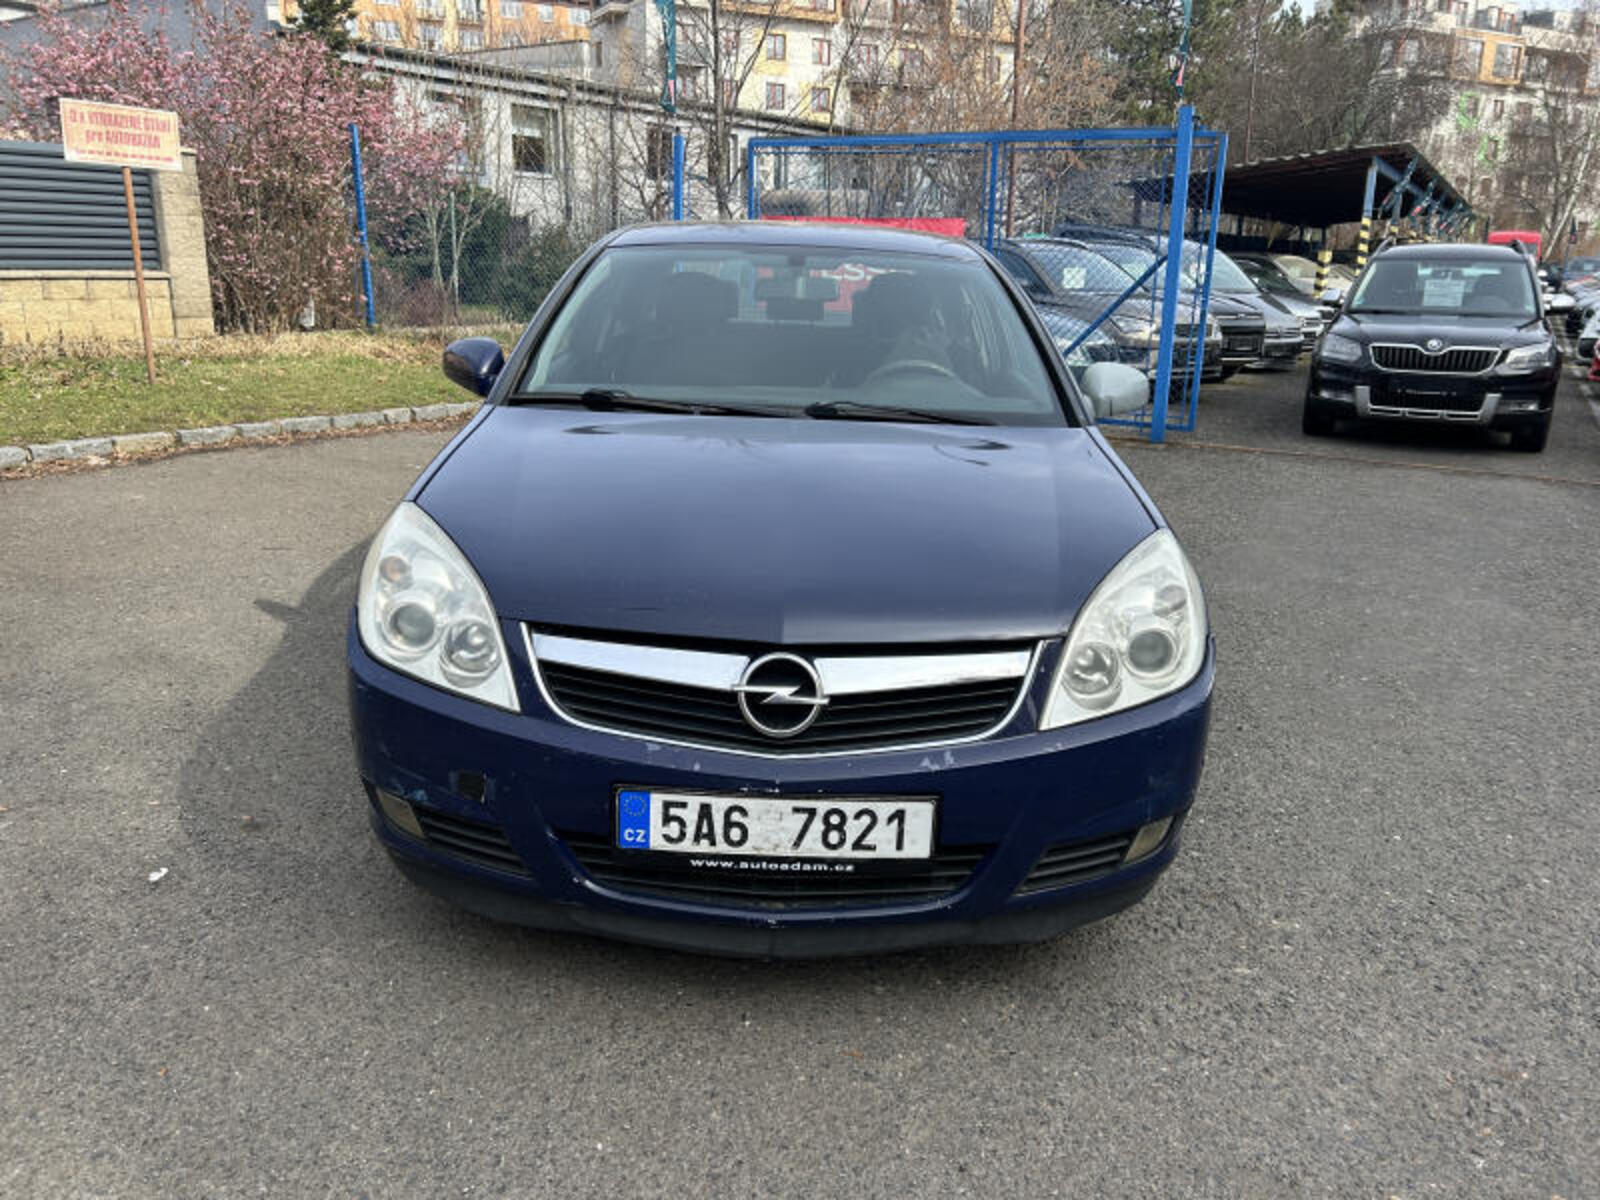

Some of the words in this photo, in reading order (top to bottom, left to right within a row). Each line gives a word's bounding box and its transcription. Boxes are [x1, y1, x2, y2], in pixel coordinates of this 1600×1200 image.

[624, 829, 646, 843] CZ
[661, 800, 749, 848] 5A6
[791, 806, 906, 851] 7821
